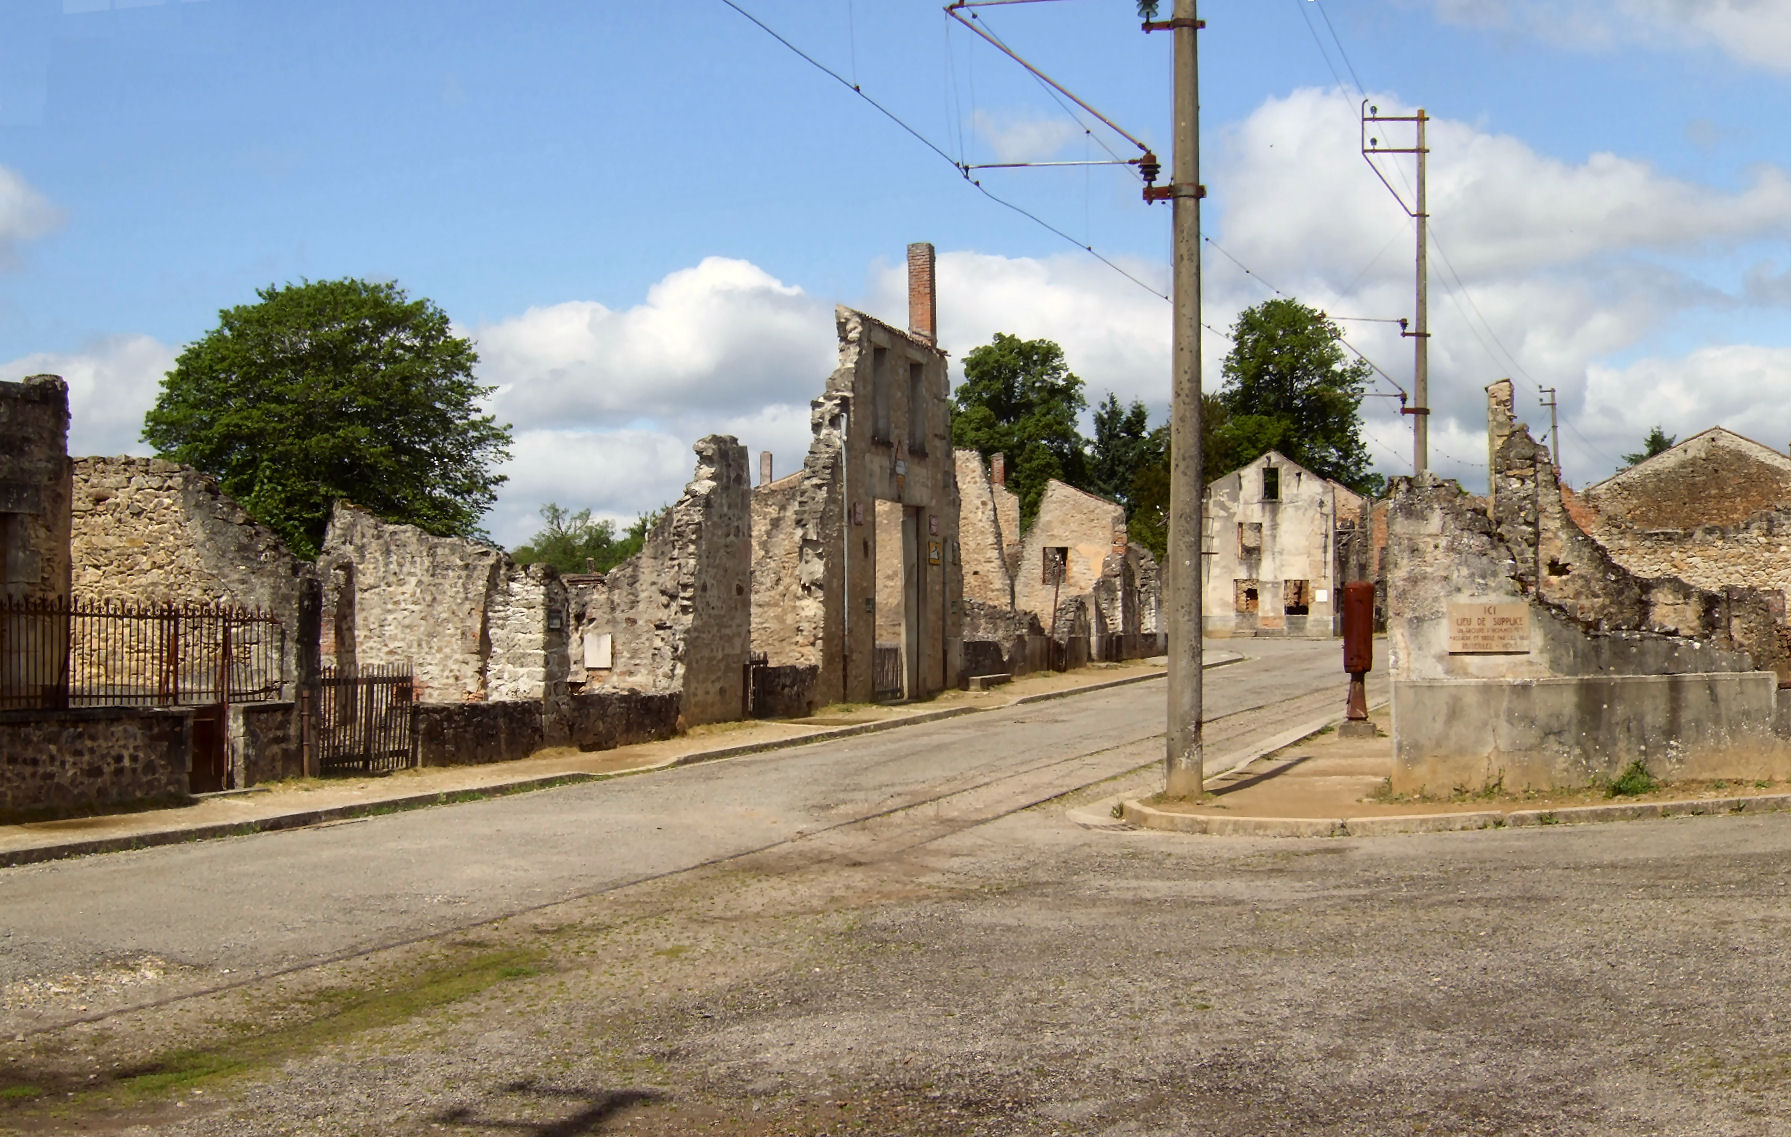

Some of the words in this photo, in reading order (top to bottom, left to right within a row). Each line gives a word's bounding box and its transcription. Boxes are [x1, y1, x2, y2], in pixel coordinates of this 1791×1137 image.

[1484, 606, 1496, 615] ICI
[1456, 617, 1472, 626] LIEU
[1477, 617, 1486, 626] DE
[1493, 617, 1523, 626] SUPPLICE
